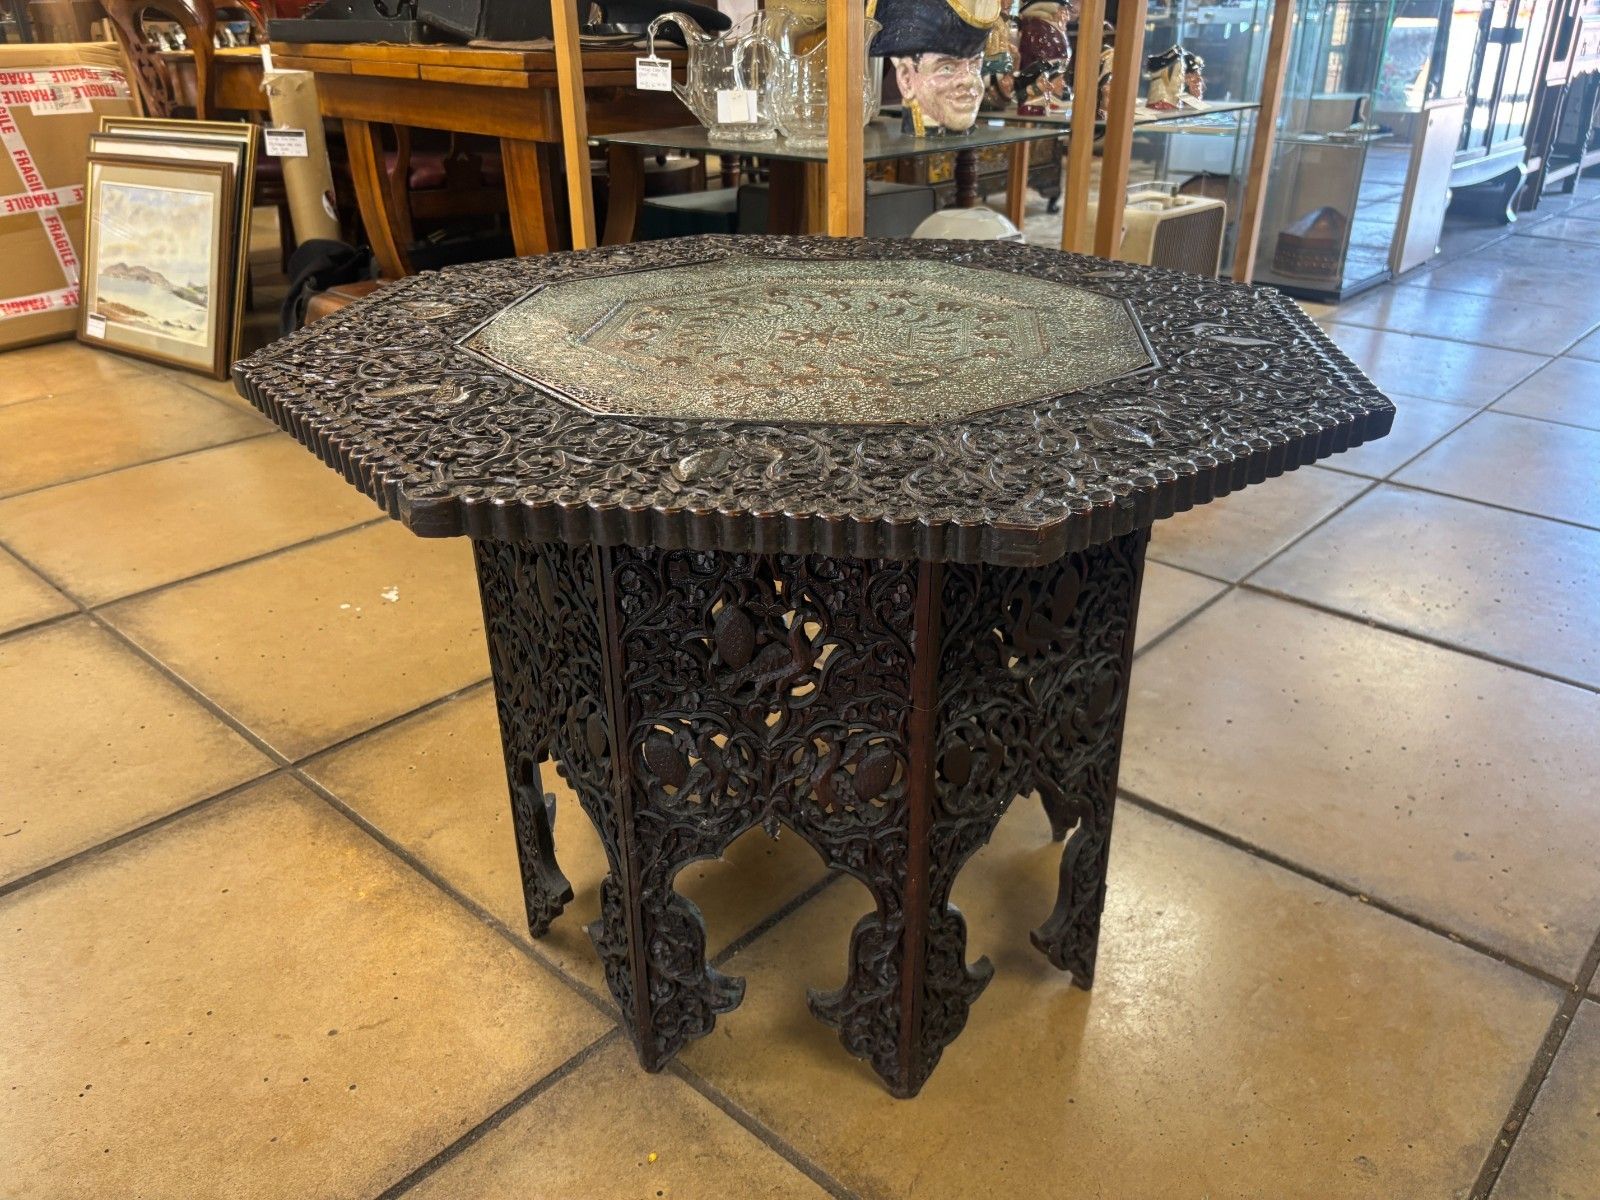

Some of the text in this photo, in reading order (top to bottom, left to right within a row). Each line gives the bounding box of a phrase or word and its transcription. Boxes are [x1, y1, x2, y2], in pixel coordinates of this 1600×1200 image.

[1, 84, 117, 104] FRAGILE FRAGILE
[13, 149, 44, 193] FRAGIL
[4, 192, 60, 212] FRAGILE
[45, 215, 77, 268] FRAGILE
